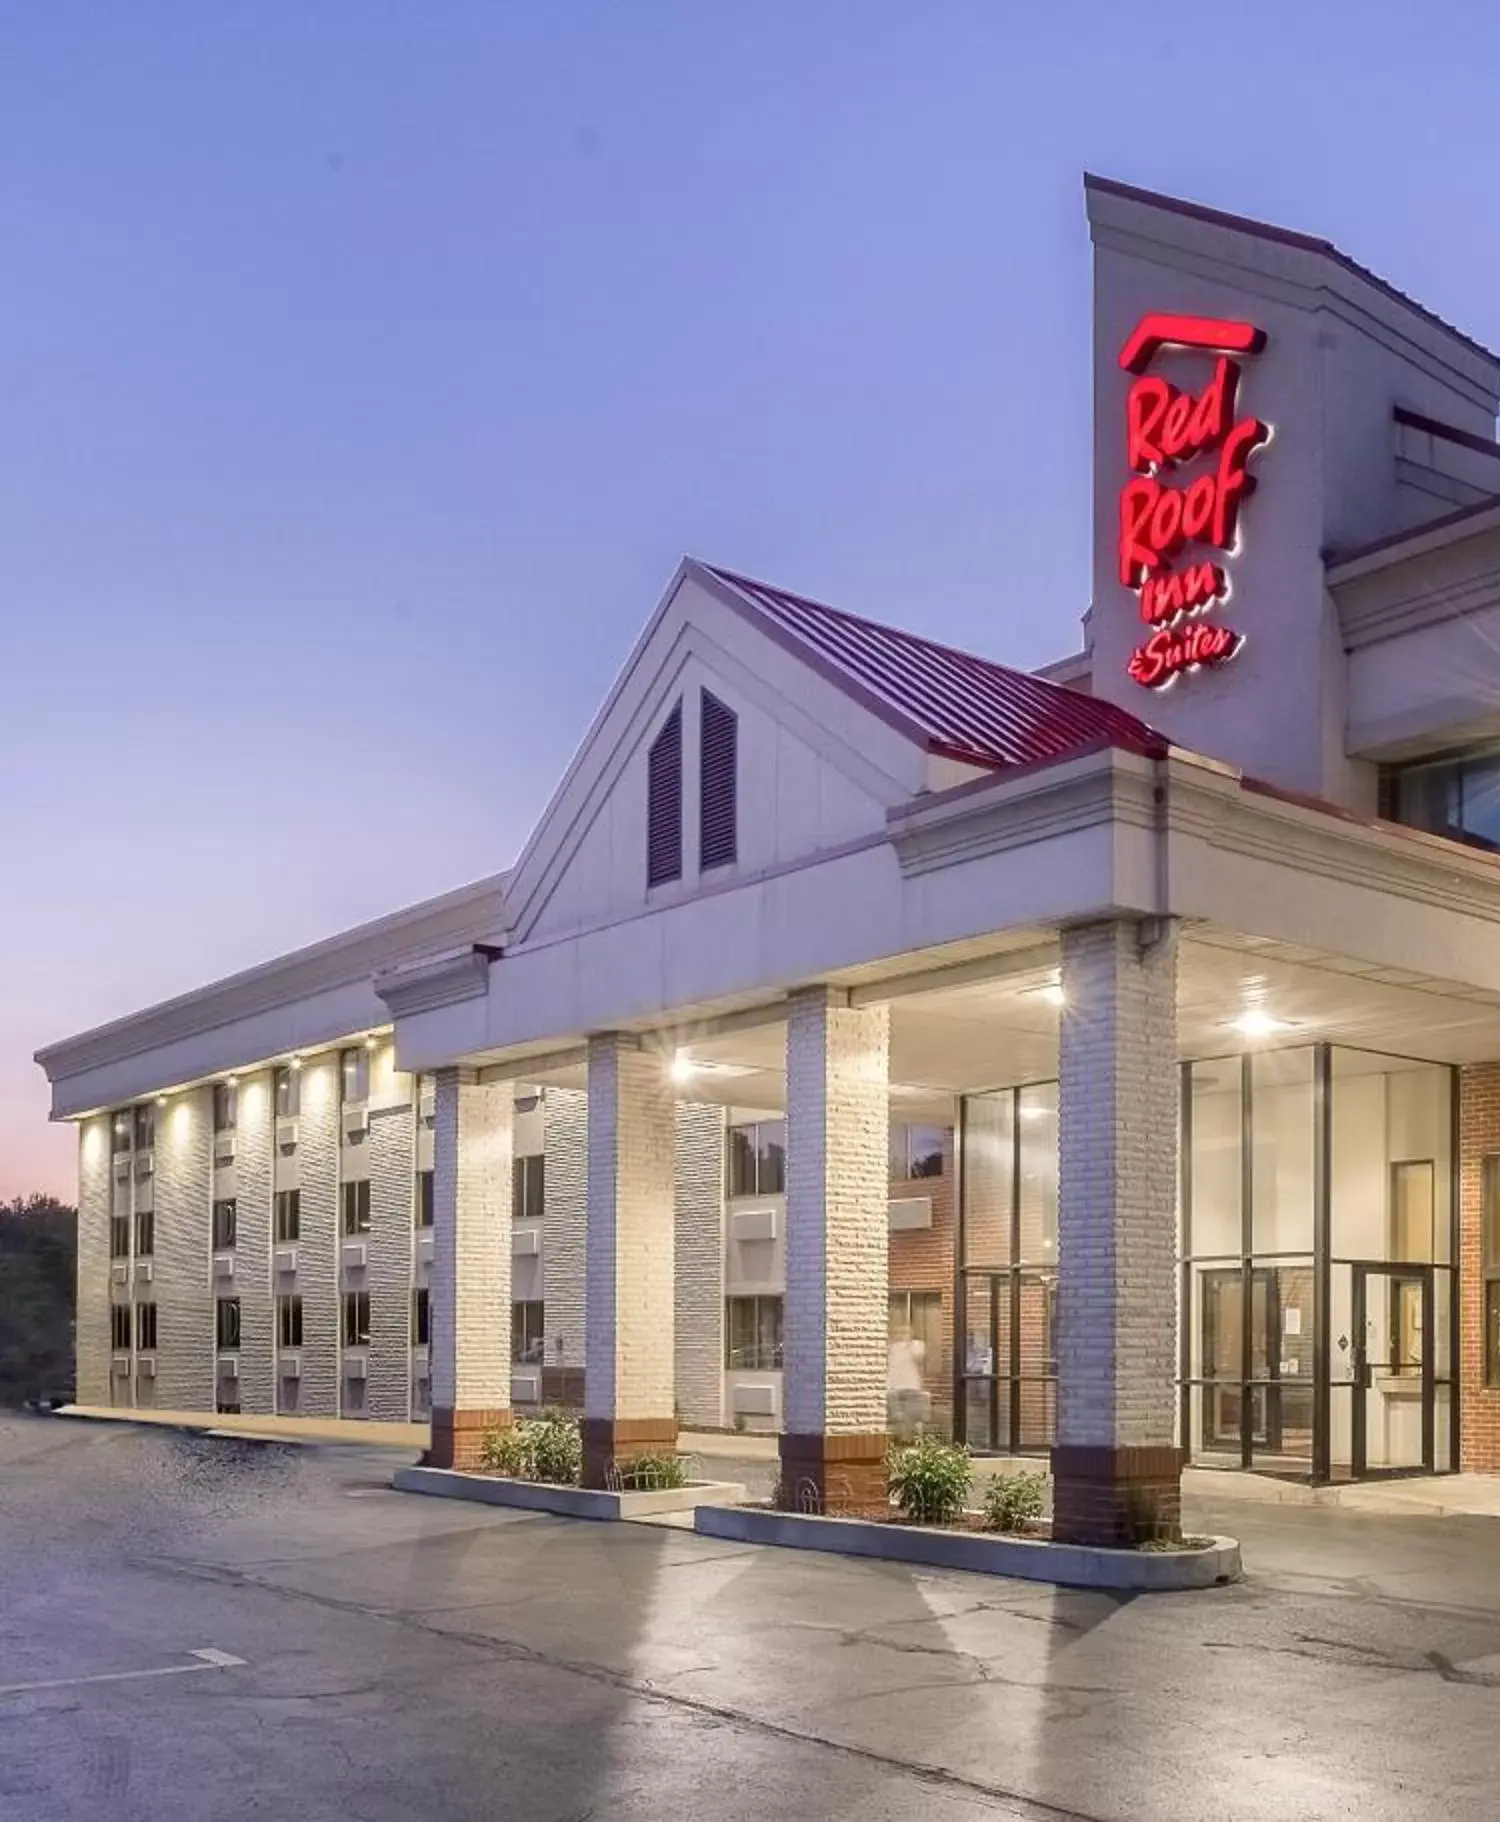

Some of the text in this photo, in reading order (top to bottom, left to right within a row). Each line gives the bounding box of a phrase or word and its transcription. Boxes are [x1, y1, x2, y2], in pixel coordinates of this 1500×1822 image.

[1127, 356, 1237, 474] Red
[1119, 418, 1260, 588] Roof
[1139, 561, 1224, 624] Inn
